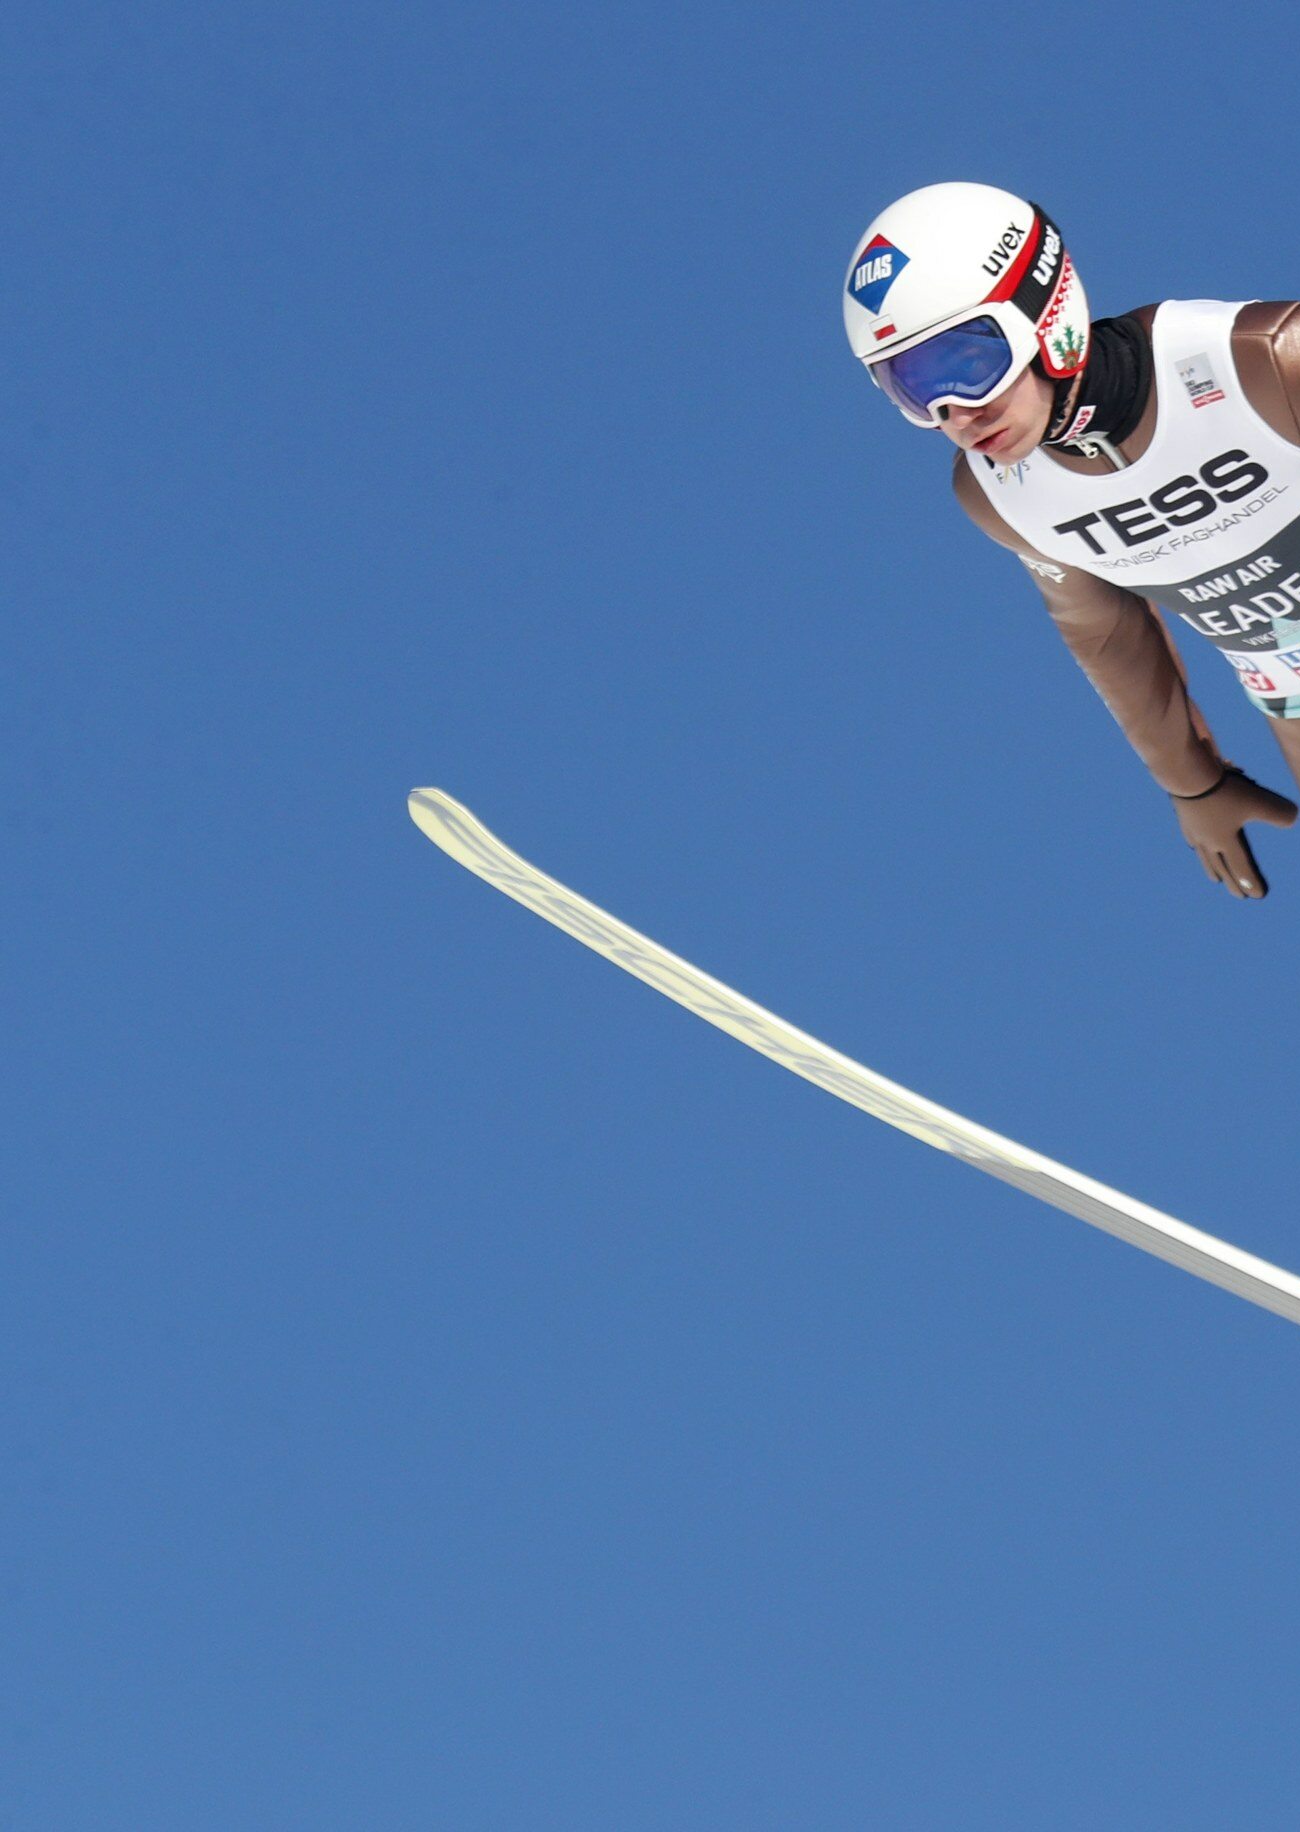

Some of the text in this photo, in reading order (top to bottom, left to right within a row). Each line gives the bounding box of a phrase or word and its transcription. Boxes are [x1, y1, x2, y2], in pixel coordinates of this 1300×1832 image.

[855, 253, 893, 292] ATLAS
[982, 222, 1025, 277] uvex
[1053, 449, 1269, 555] TESS
[1169, 485, 1289, 551] FAGHANDEL
[1178, 555, 1282, 603] RAW AIR
